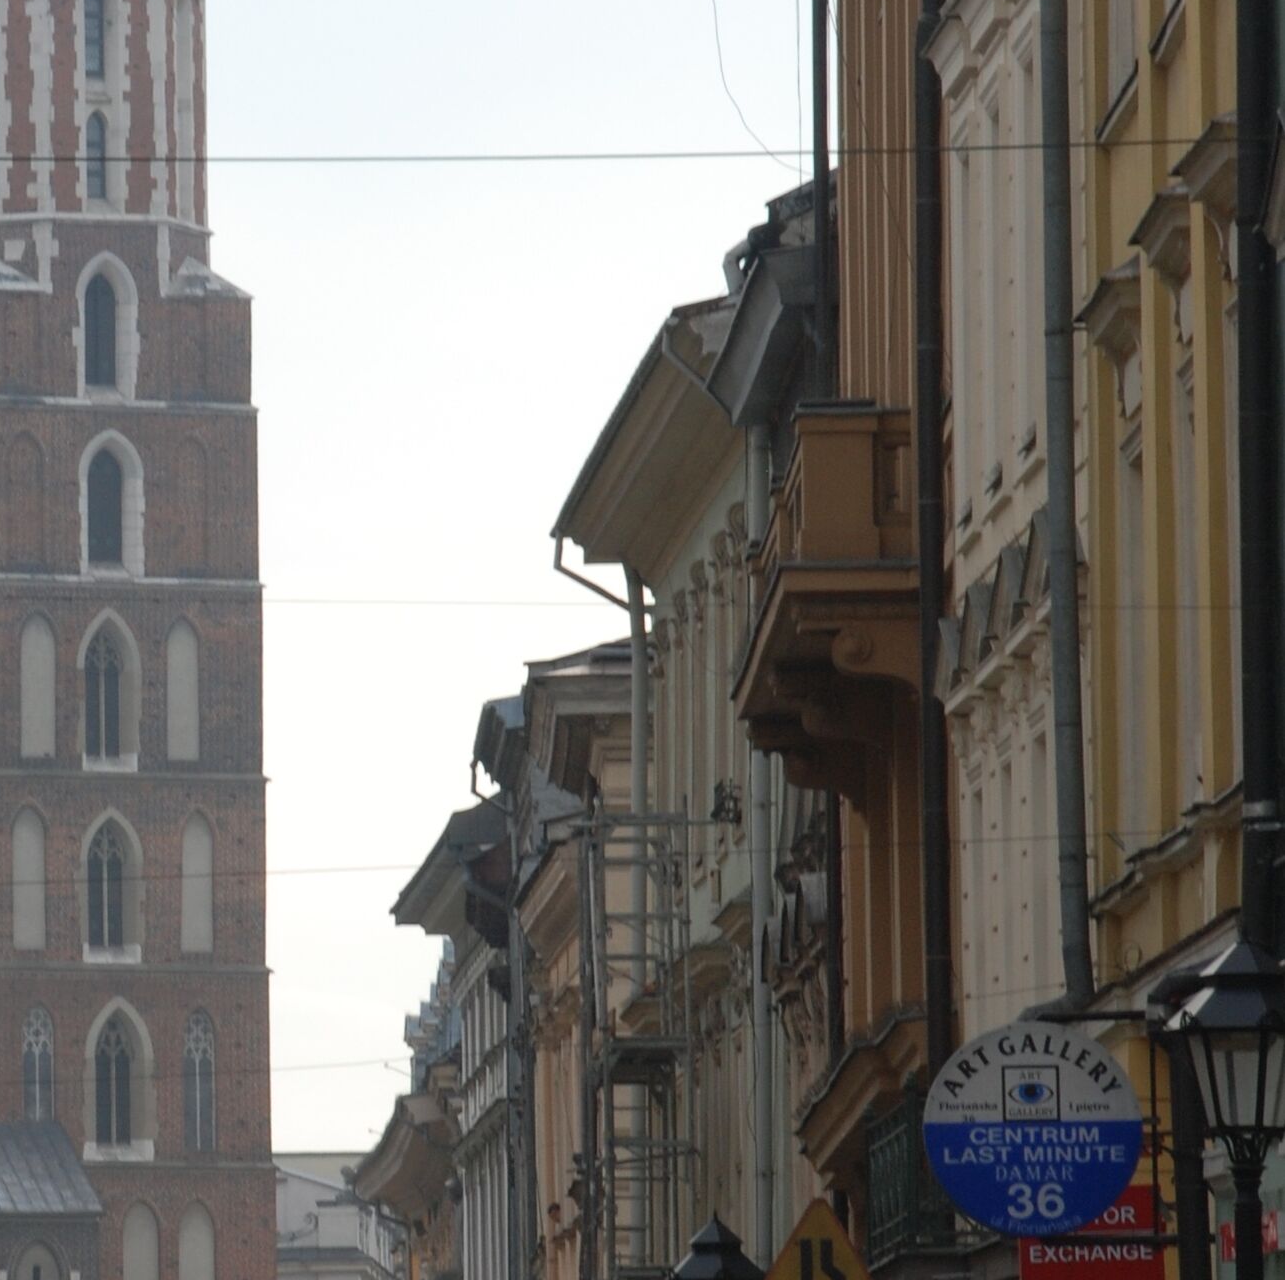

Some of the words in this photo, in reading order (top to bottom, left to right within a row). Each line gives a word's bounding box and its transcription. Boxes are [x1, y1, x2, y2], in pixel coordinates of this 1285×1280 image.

[943, 1046, 990, 1098] ART
[998, 1033, 1123, 1095] GALLERY
[1018, 1071, 1042, 1081] ART
[1008, 1108, 1055, 1117] GALLERY
[969, 1126, 1101, 1146] CENTRUM
[943, 1145, 1012, 1165] LAST
[1023, 1144, 1126, 1163] MINUTE
[995, 1166, 1074, 1182] DAMAR
[1007, 1182, 1066, 1220] 36
[1029, 1244, 1155, 1264] EXCHANGE
